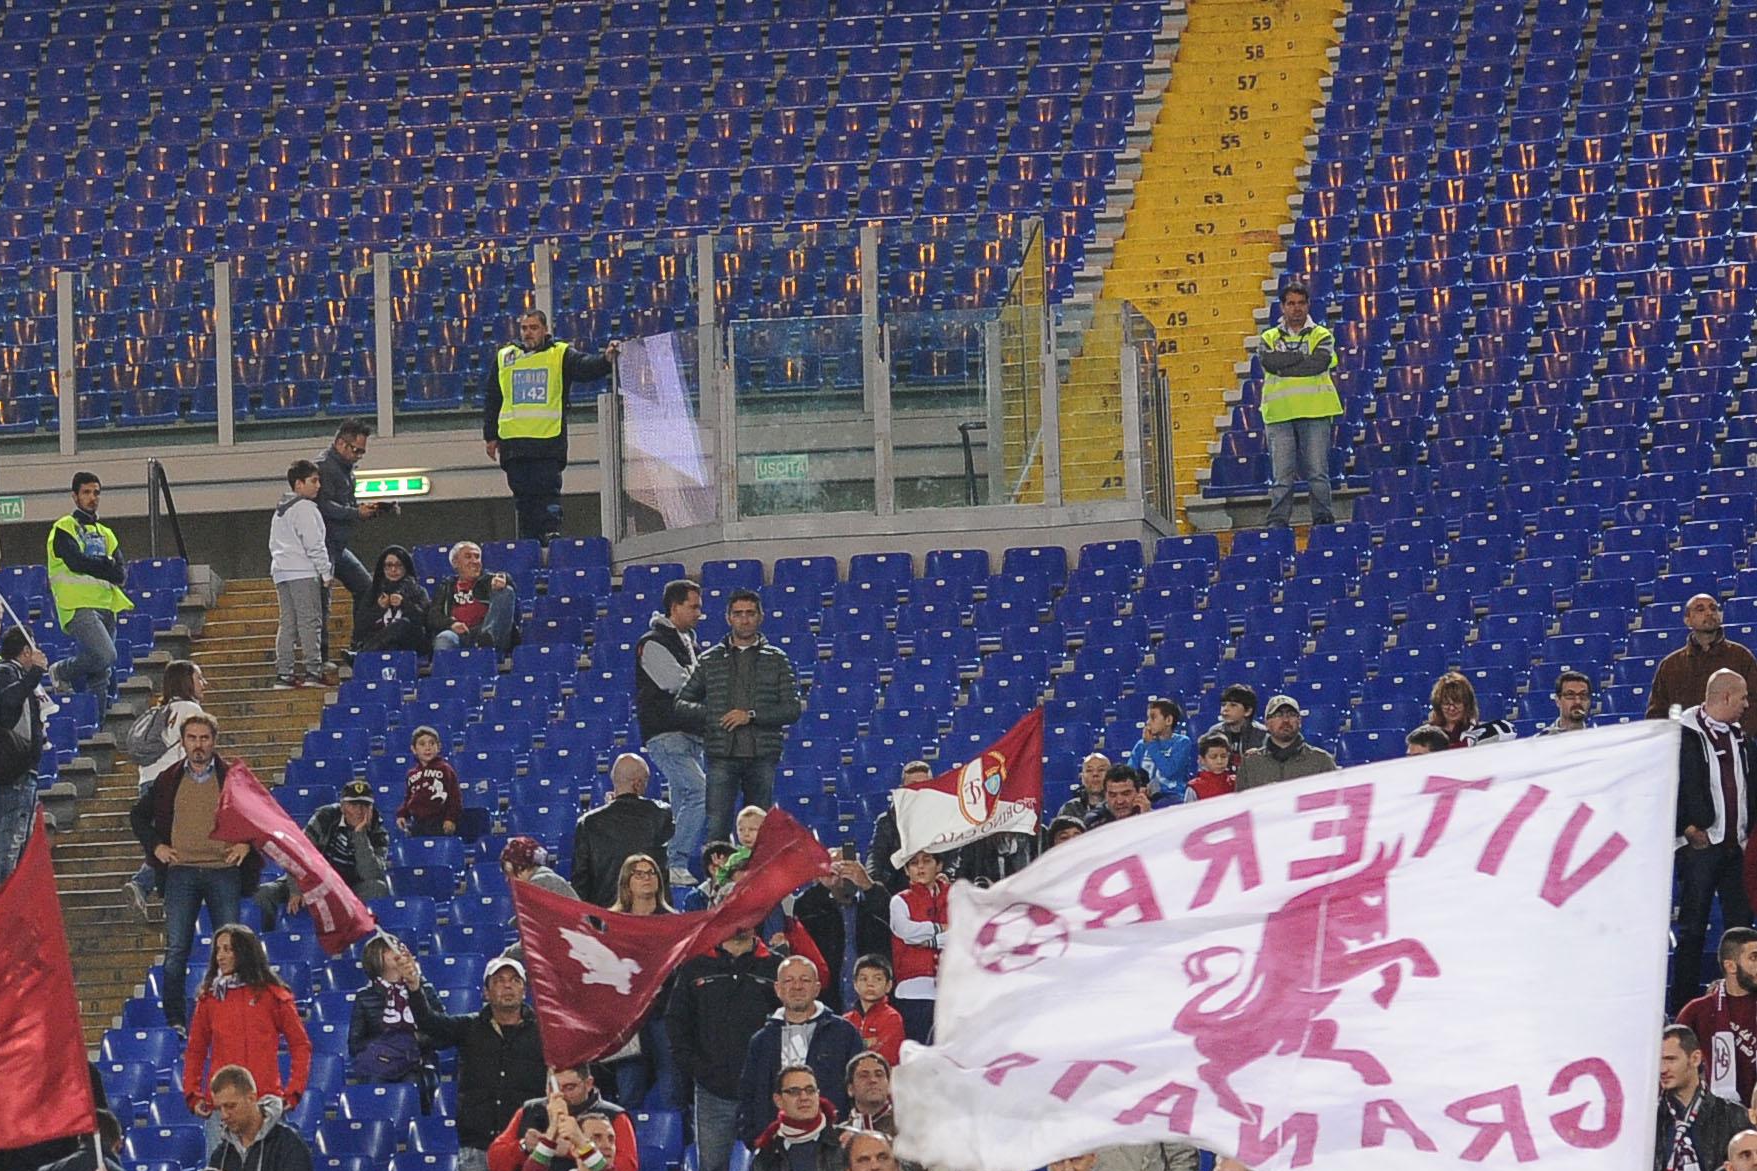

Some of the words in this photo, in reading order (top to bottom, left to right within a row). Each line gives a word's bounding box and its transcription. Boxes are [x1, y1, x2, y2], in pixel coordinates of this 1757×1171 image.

[1252, 17, 1271, 31] 59
[1246, 45, 1264, 61] 58
[1238, 76, 1256, 90] 57
[1230, 106, 1248, 120] 56
[1221, 135, 1240, 149] 55
[1213, 165, 1232, 176] 54
[1205, 194, 1222, 204] 53
[1196, 223, 1214, 233] 52
[1186, 252, 1204, 264] 51
[1177, 282, 1197, 294] 50
[1167, 312, 1187, 325] 49
[1157, 341, 1177, 353] 48
[759, 462, 805, 475] USCITA
